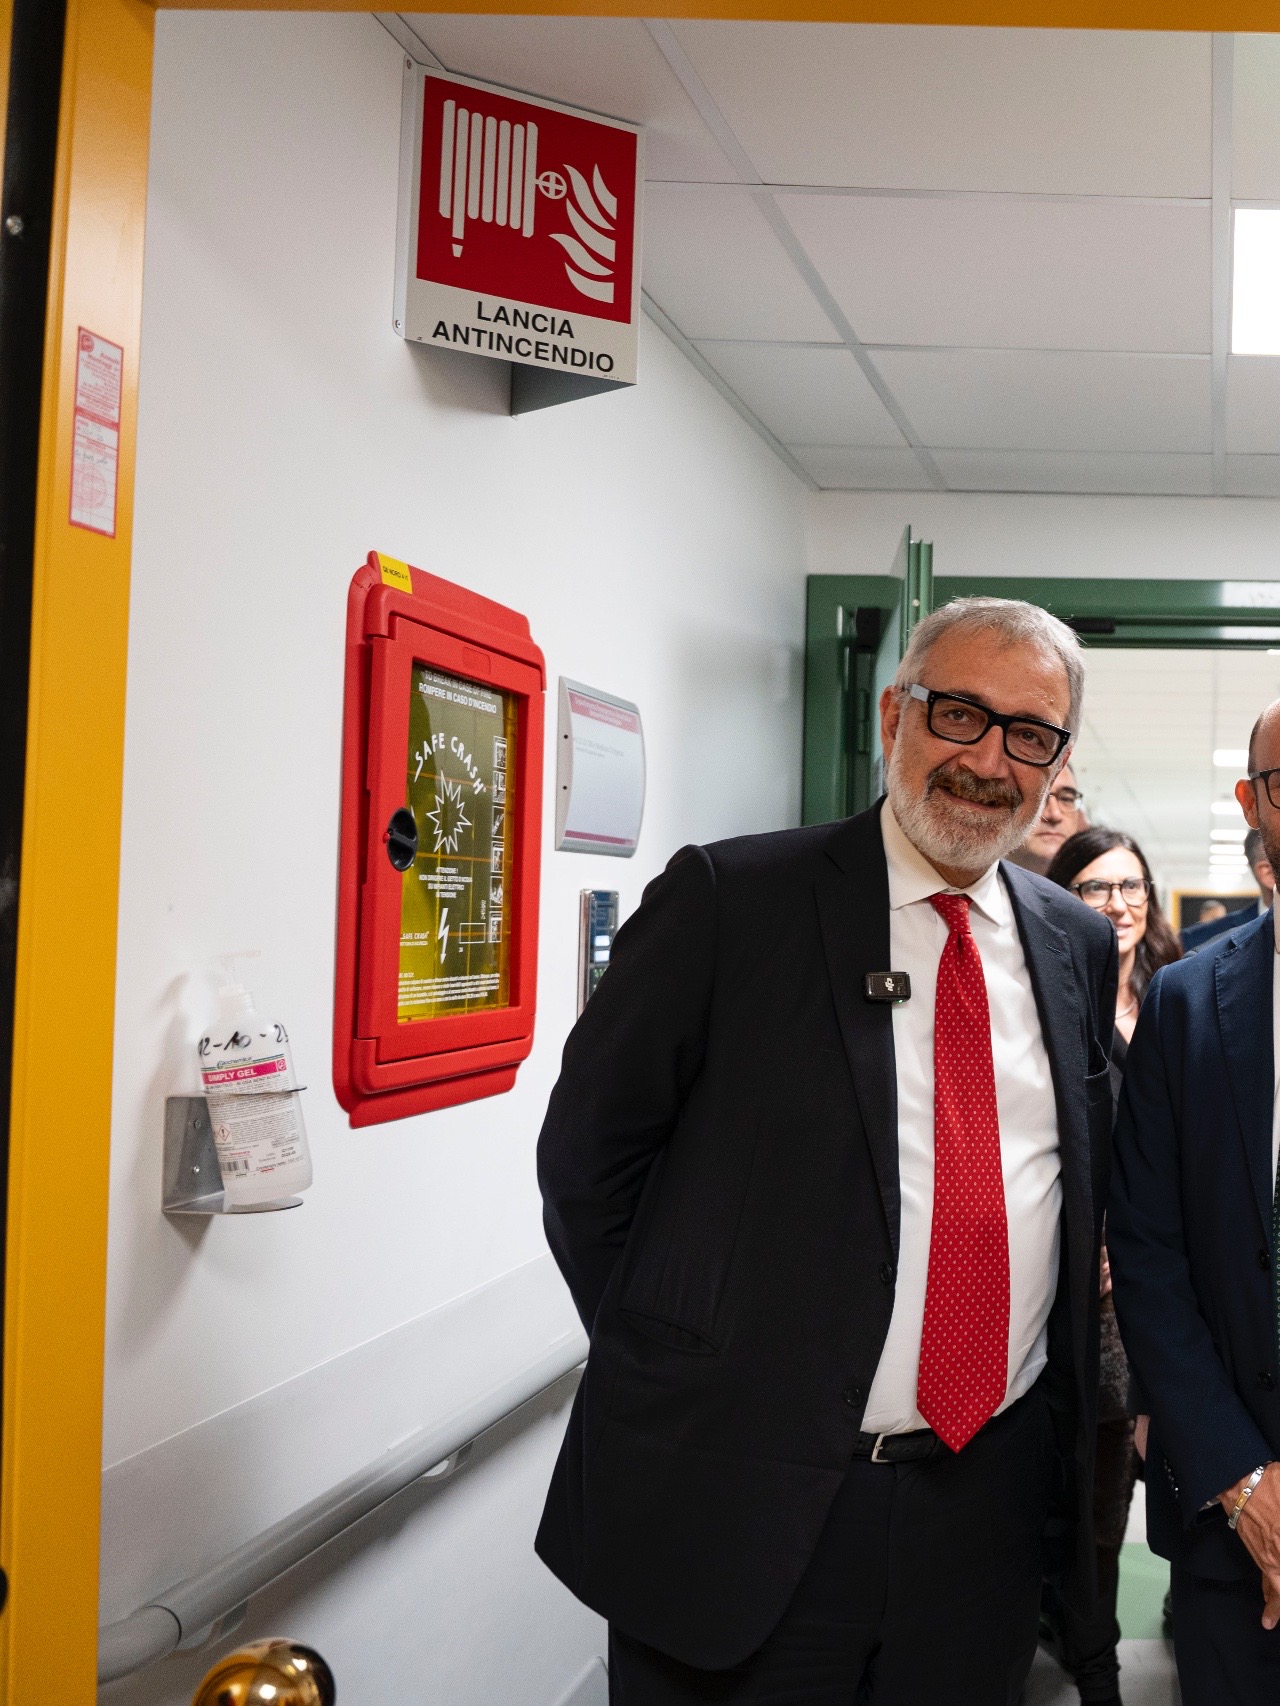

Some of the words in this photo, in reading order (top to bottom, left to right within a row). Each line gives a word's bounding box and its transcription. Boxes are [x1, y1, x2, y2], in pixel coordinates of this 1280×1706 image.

[477, 301, 575, 339] LANCIA
[431, 320, 615, 373] ANTINCENDIO
[419, 682, 446, 699] ROMPERE
[446, 691, 453, 701] IN
[453, 693, 468, 706] CASO
[468, 697, 497, 714] D'INCENDIO
[414, 732, 446, 783] SAFE
[450, 736, 484, 795] CRASH
[208, 1071, 235, 1082] SIMPLY
[237, 1068, 257, 1078] GEL
